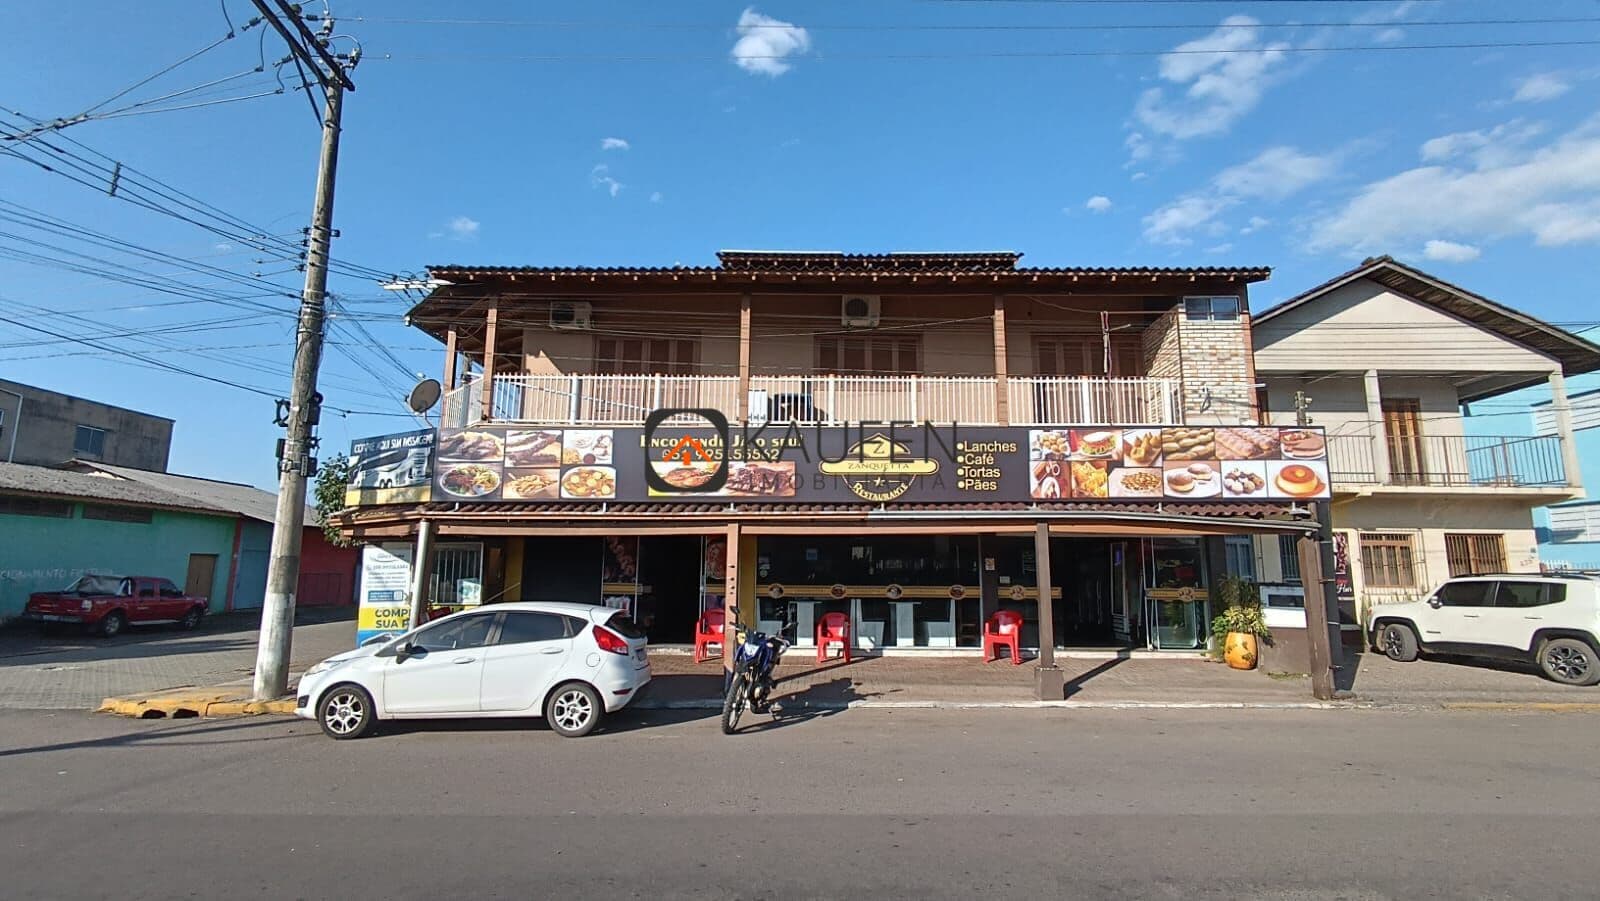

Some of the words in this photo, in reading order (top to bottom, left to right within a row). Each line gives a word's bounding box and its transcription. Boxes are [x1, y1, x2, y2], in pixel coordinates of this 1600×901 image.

[391, 437, 402, 449] SUA
[872, 441, 885, 454] Z
[964, 440, 1017, 453] Lanches
[964, 453, 994, 465] Café
[962, 466, 1001, 478] Tortas
[965, 478, 997, 491] Pães
[375, 608, 411, 618] COMP
[375, 619, 398, 629] SUA
